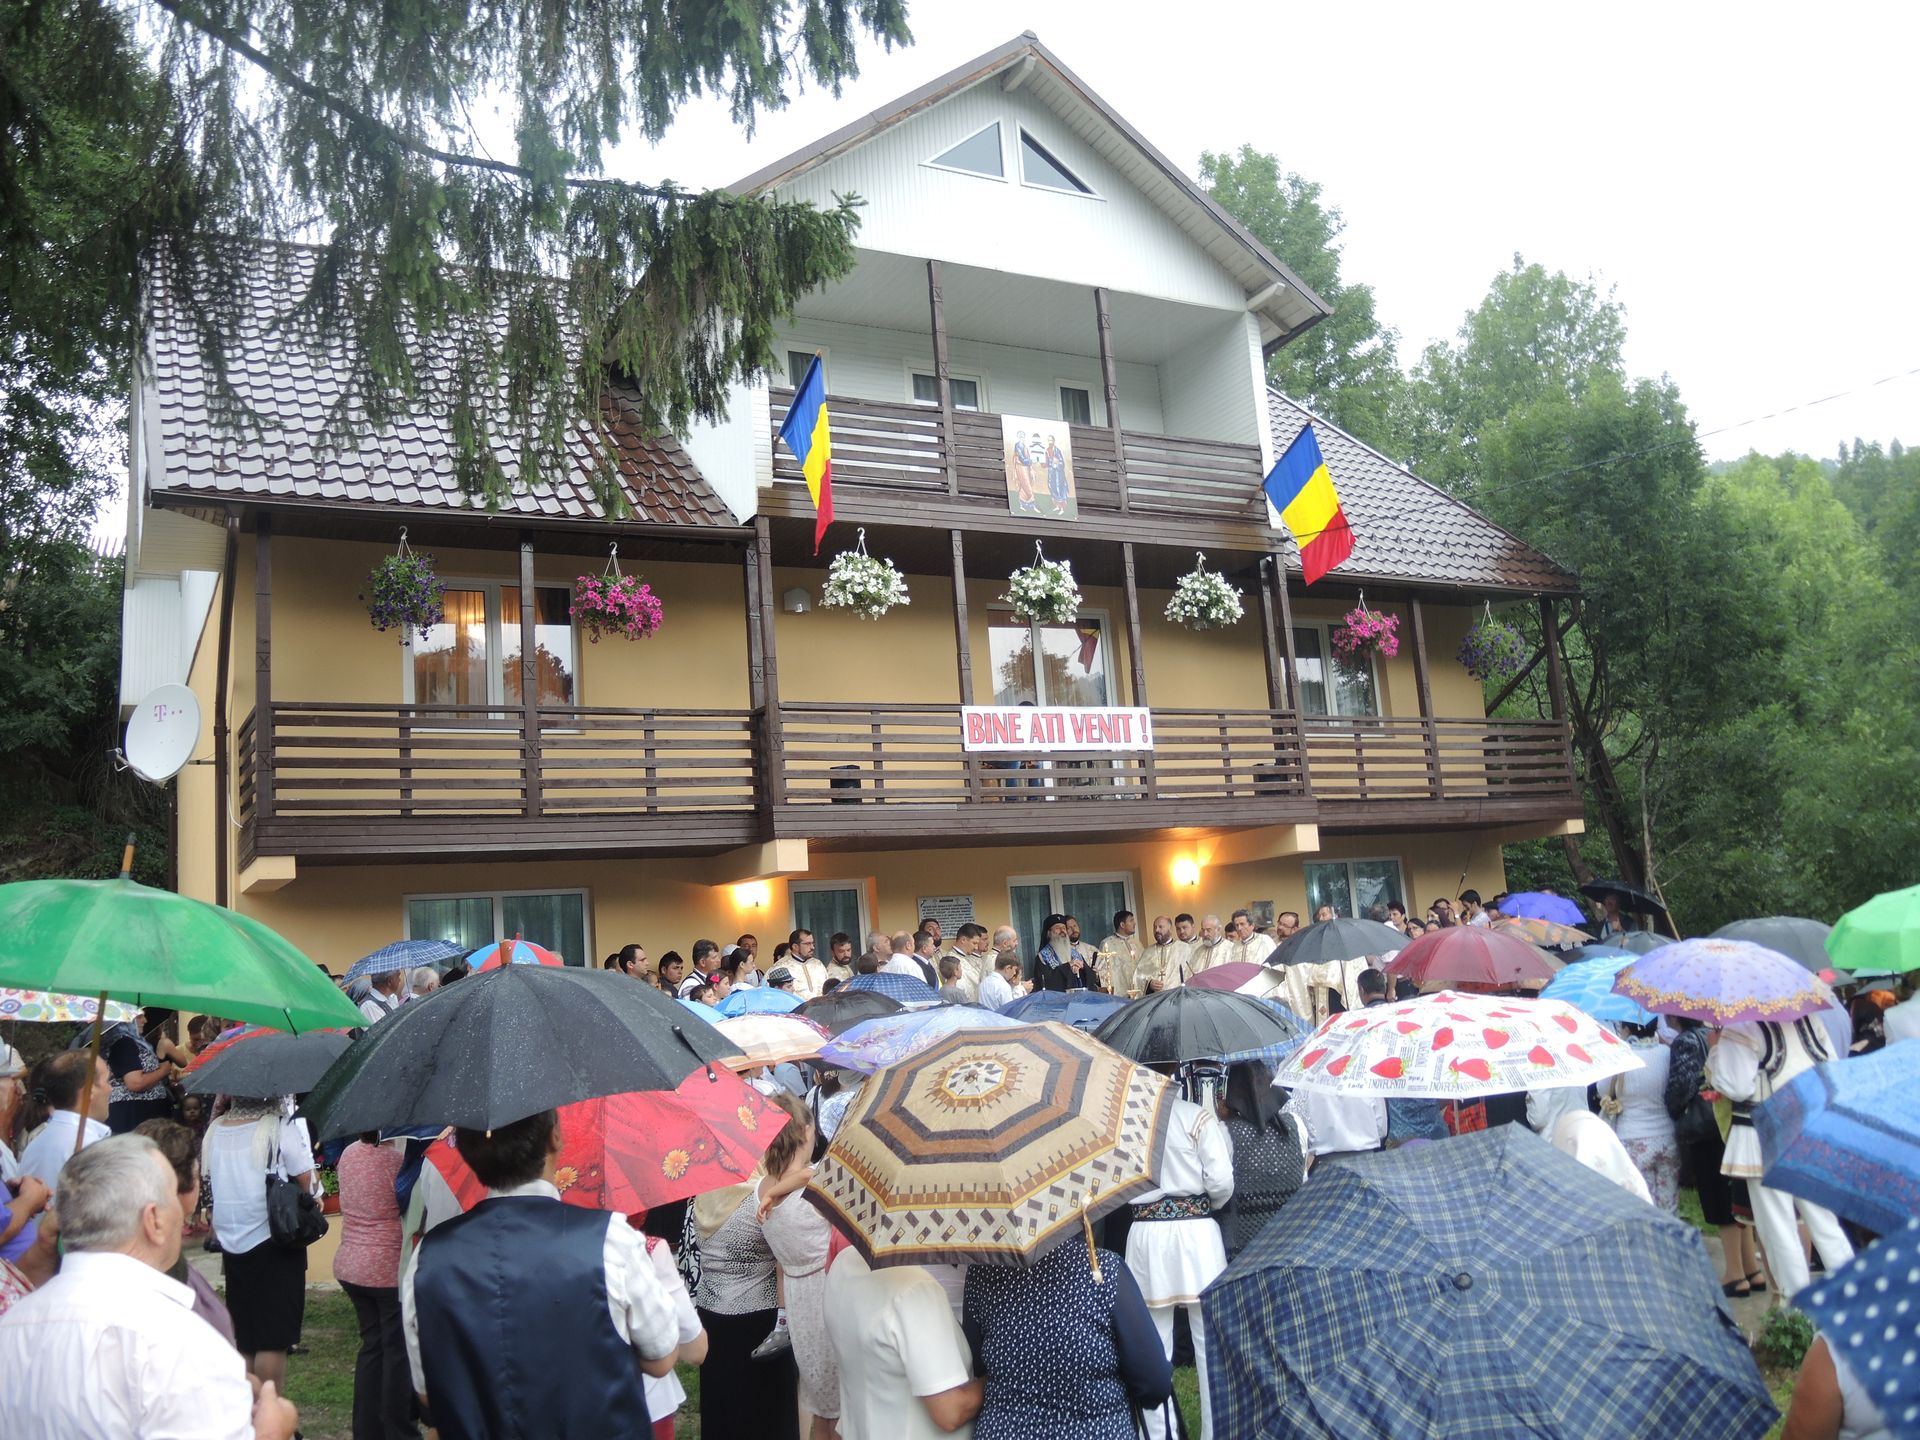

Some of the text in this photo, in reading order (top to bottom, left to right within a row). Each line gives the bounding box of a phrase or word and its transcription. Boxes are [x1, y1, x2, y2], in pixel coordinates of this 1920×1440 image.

[967, 713, 1024, 744] BINE
[1030, 713, 1065, 743] ATI
[1070, 713, 1132, 743] VENIT
